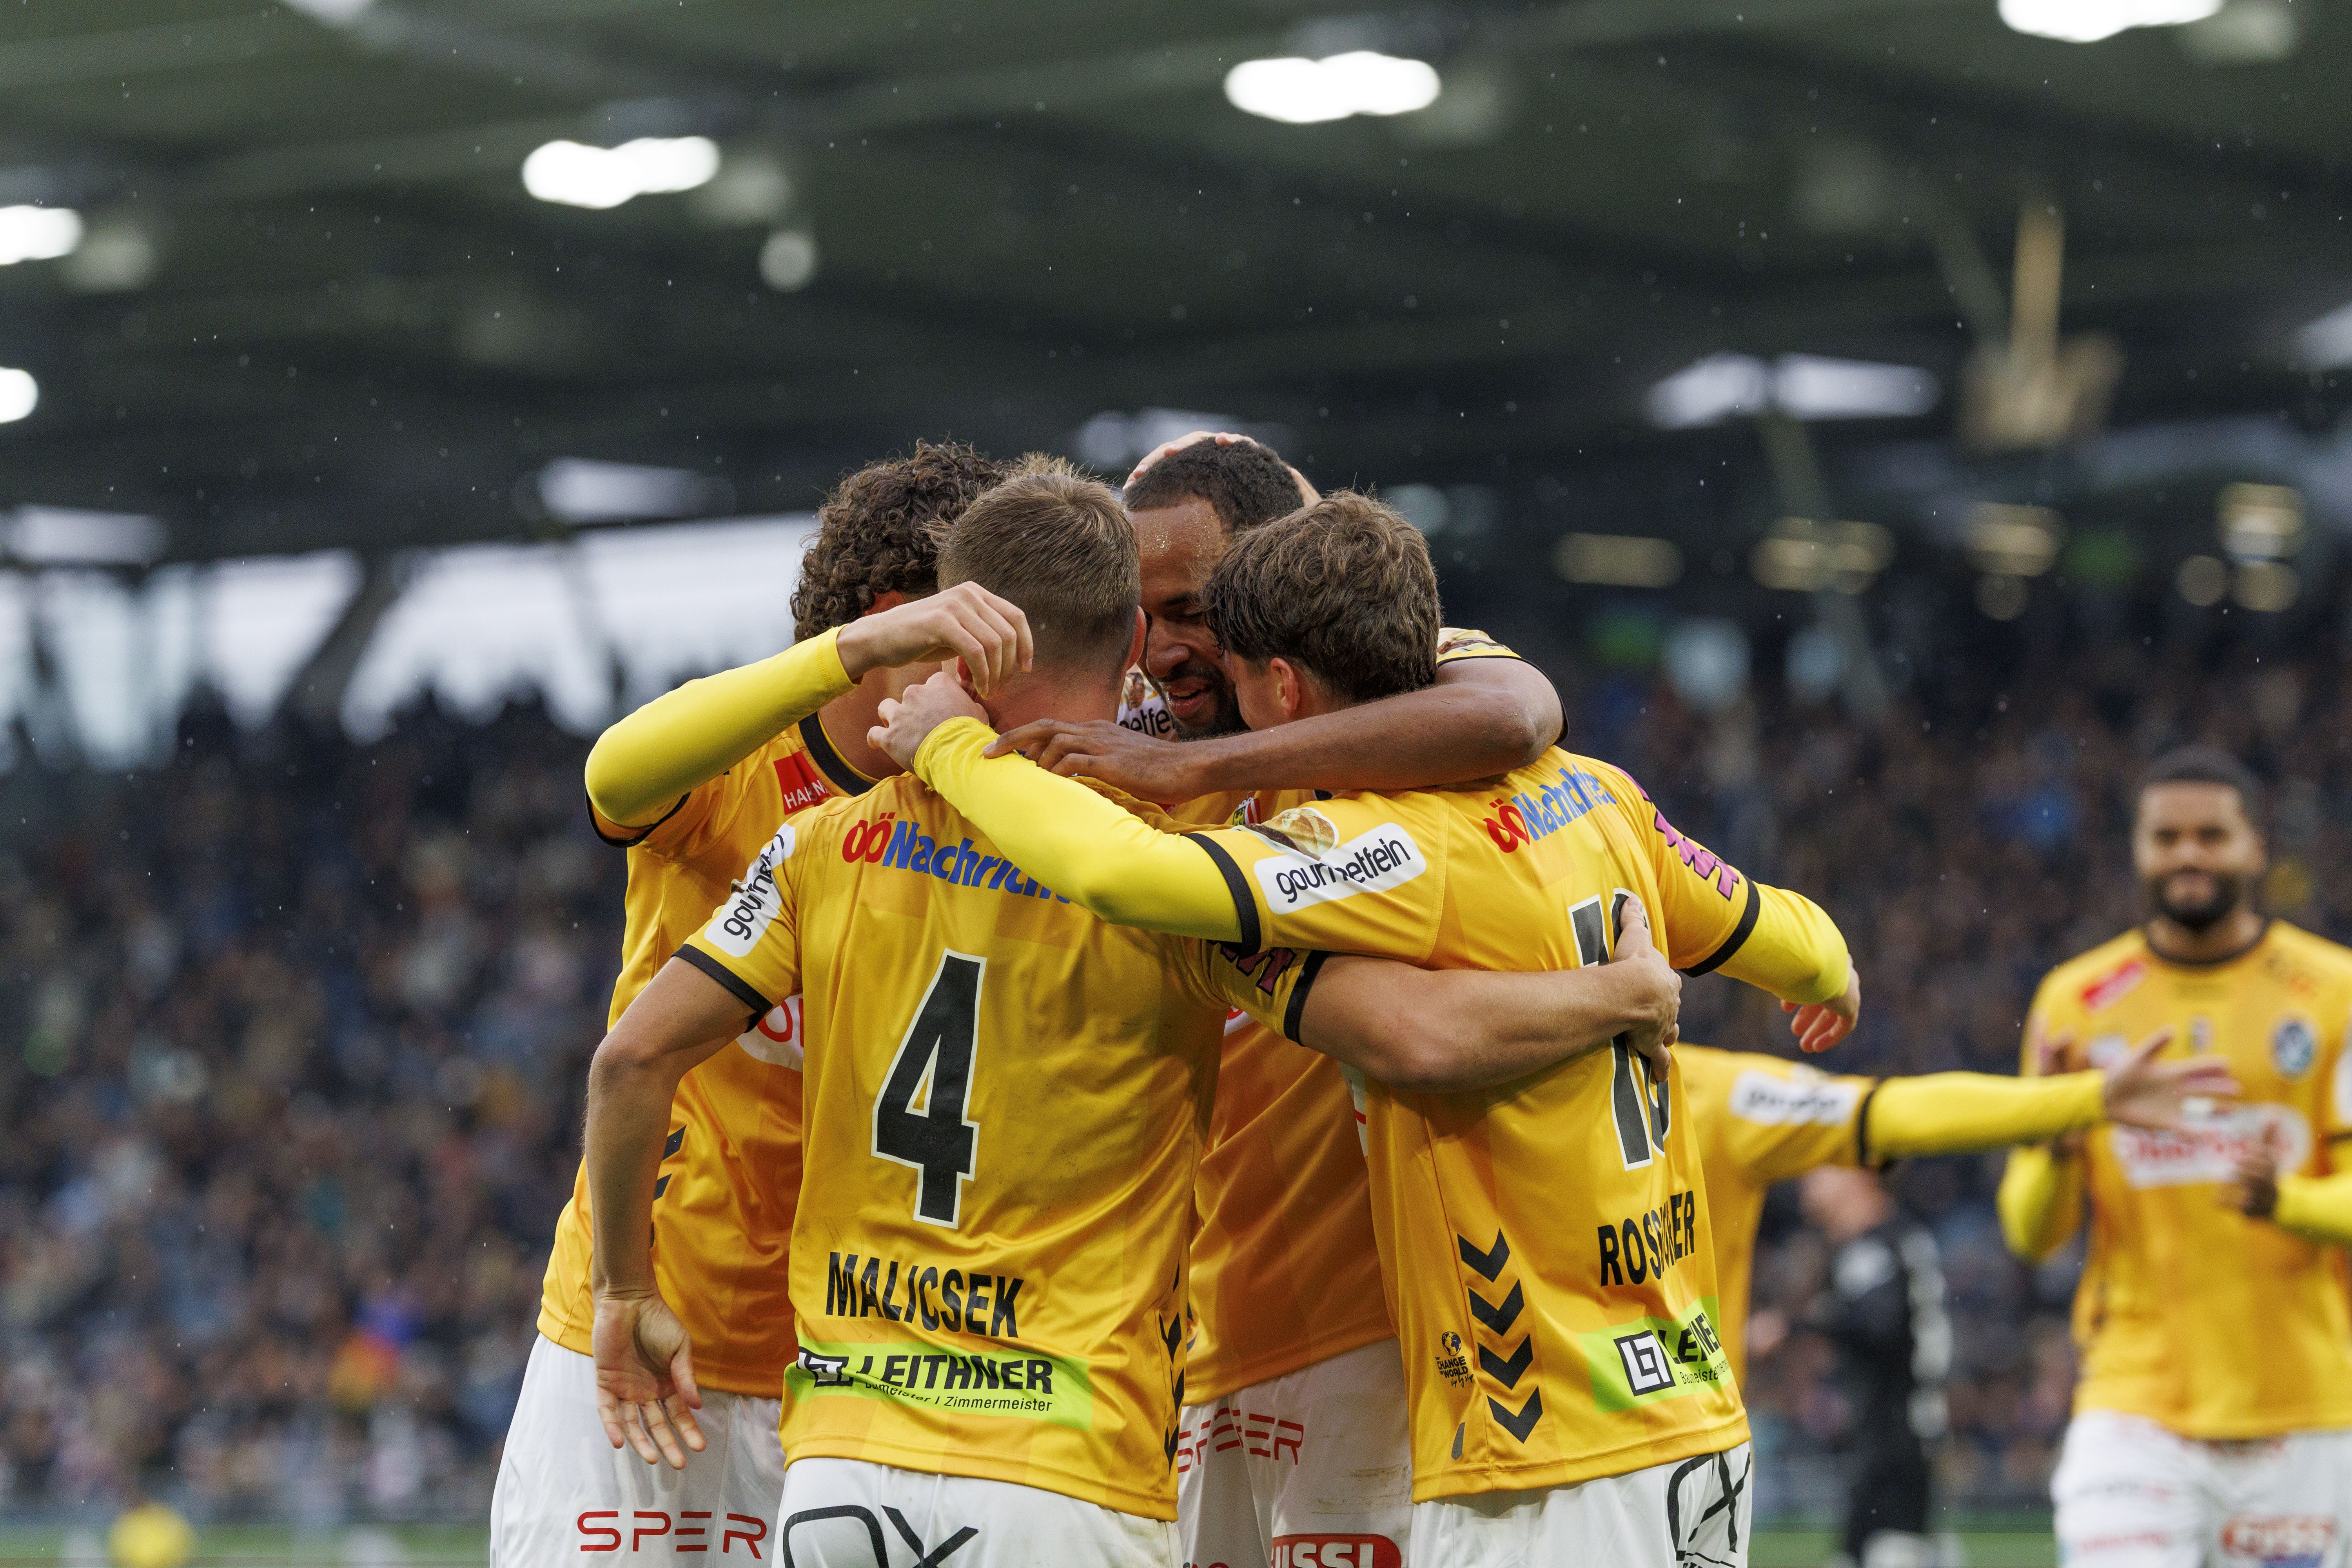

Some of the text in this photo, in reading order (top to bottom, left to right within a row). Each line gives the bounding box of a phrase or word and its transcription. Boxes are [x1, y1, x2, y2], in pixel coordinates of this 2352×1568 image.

[871, 947, 987, 1230] 4
[826, 1251, 1024, 1338] MALICSEK
[856, 1355, 1053, 1394] LEITHNER
[1437, 1356, 1466, 1370] CHANGE
[1443, 1366, 1468, 1378] WORLD
[944, 1396, 1053, 1411] Zimmermeister
[577, 1511, 767, 1560] SPER
